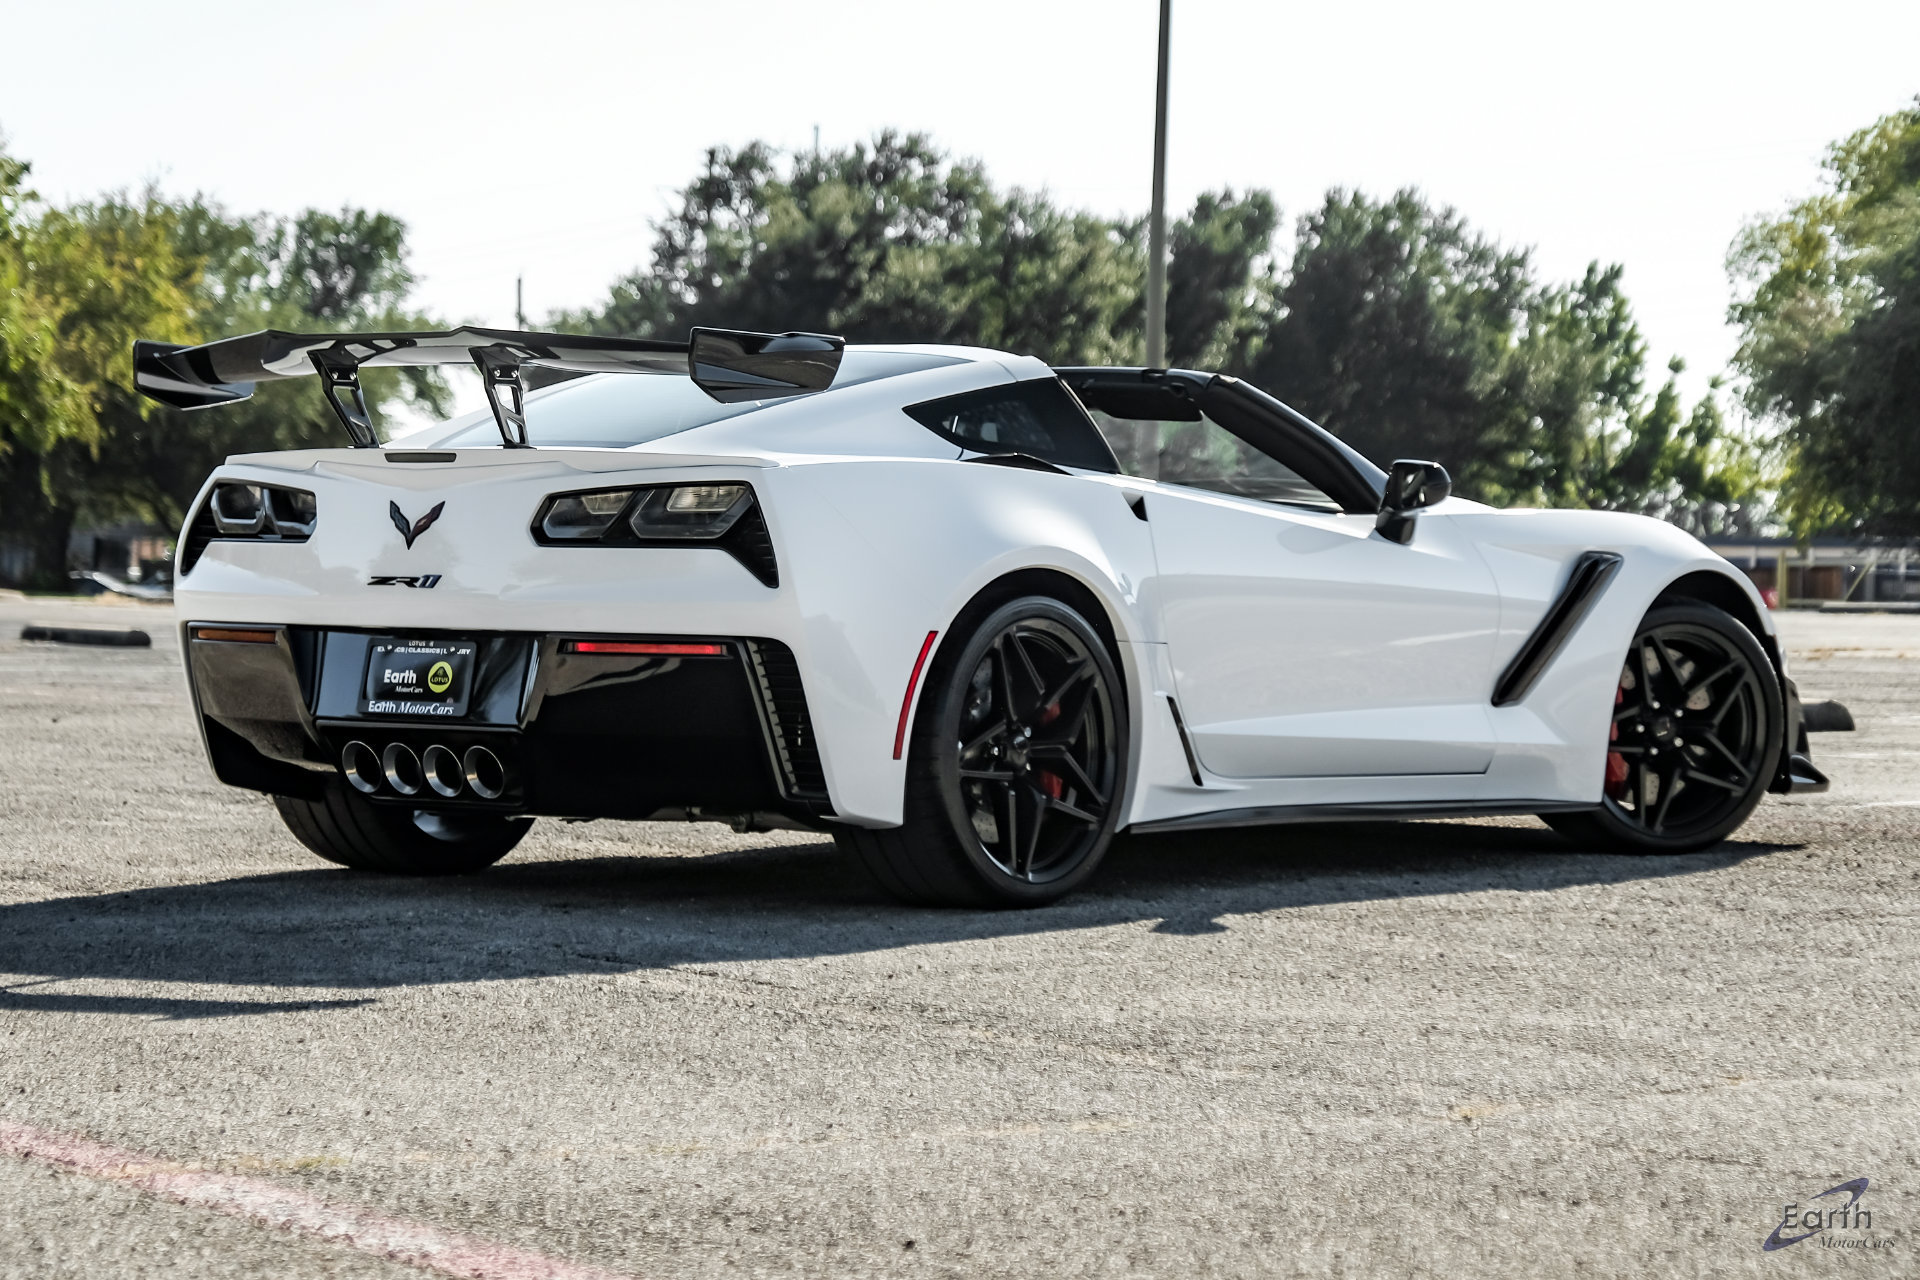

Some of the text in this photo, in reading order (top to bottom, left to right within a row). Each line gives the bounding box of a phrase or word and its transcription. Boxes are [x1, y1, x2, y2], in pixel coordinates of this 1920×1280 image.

[367, 574, 442, 588] ZR1
[383, 669, 417, 684] Earth
[368, 701, 454, 715] Earth MotorCars
